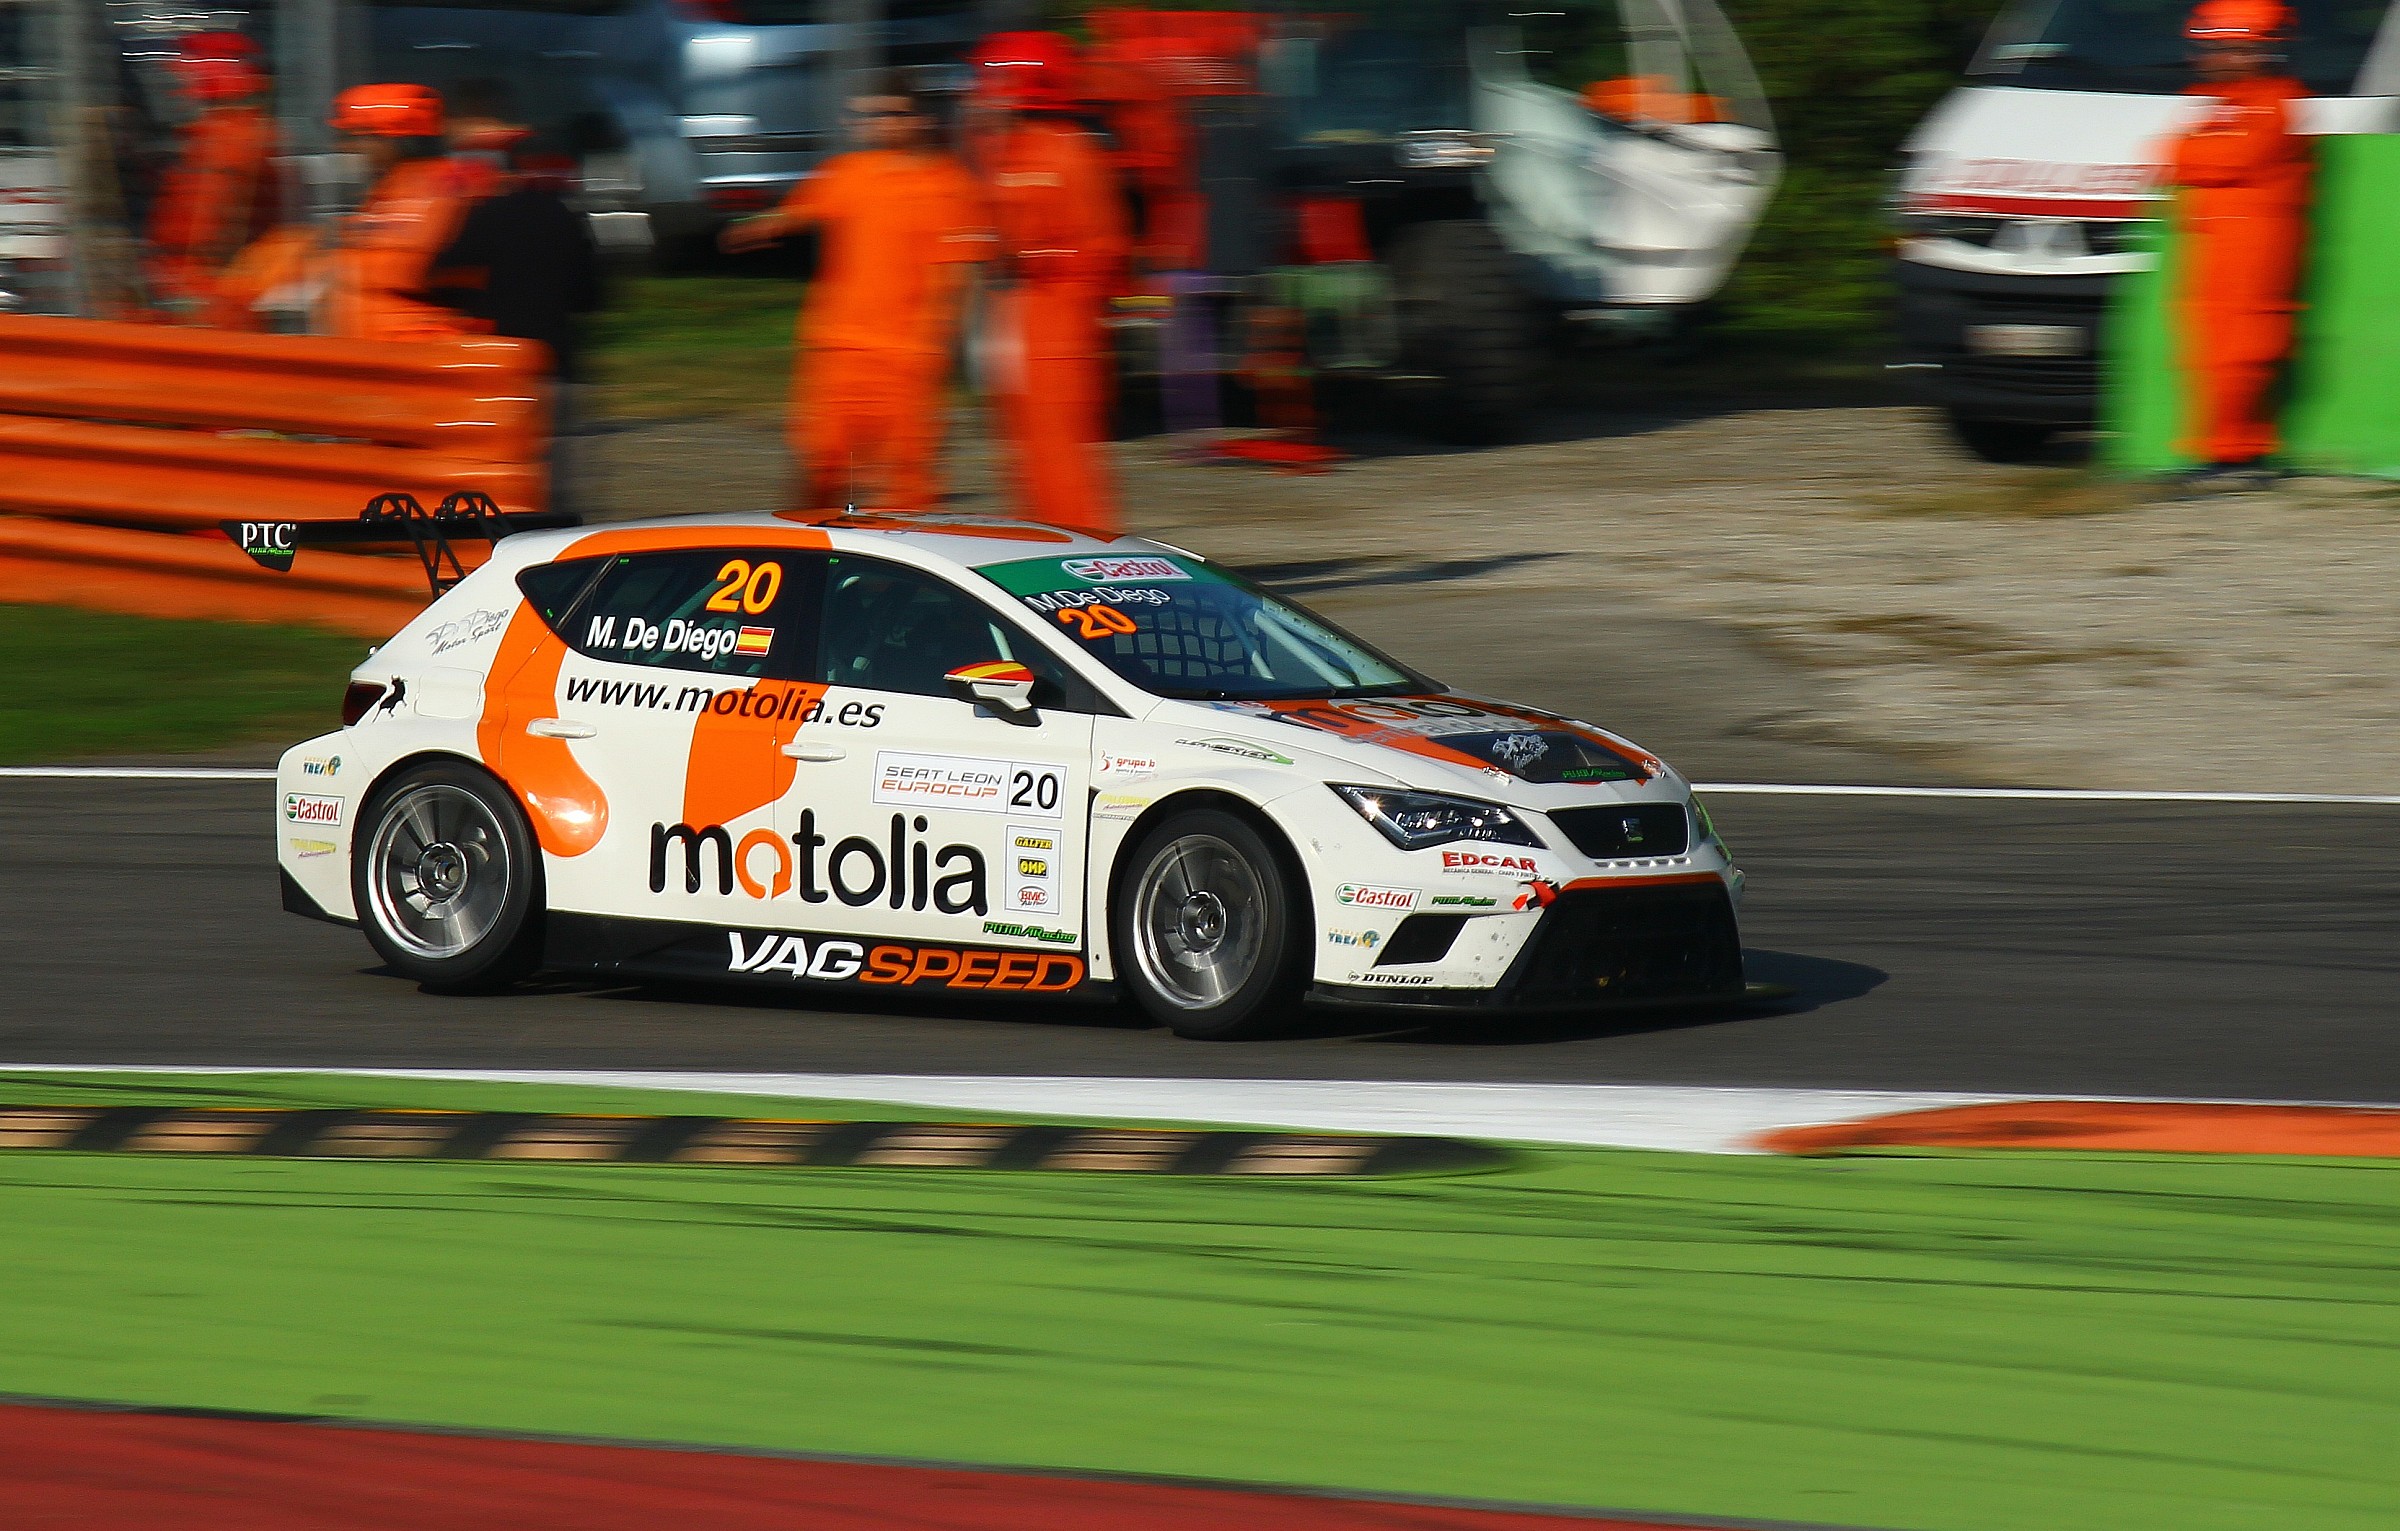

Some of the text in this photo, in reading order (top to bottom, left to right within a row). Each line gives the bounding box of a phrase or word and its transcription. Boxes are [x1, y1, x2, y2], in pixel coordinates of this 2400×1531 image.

[1093, 558, 1182, 578] Castrol
[705, 559, 783, 615] 20
[1092, 586, 1171, 608] Diego
[1057, 604, 1138, 640] 20
[586, 616, 736, 661] M. De Diego
[566, 676, 885, 728] www.motolia.es
[1117, 758, 1155, 768] grupo b
[885, 766, 1002, 785] SEAT LEON
[881, 779, 998, 798] EUROCUP
[1011, 769, 1059, 810] 20
[297, 798, 339, 821] Castrol
[1015, 837, 1053, 850] GALFER
[648, 808, 987, 916] motolia
[1020, 860, 1046, 875] OMP
[1442, 851, 1538, 873] EDCAR
[1020, 890, 1045, 901] BMC
[1356, 887, 1414, 907] Castrol
[1362, 973, 1434, 984] DUNLOP
